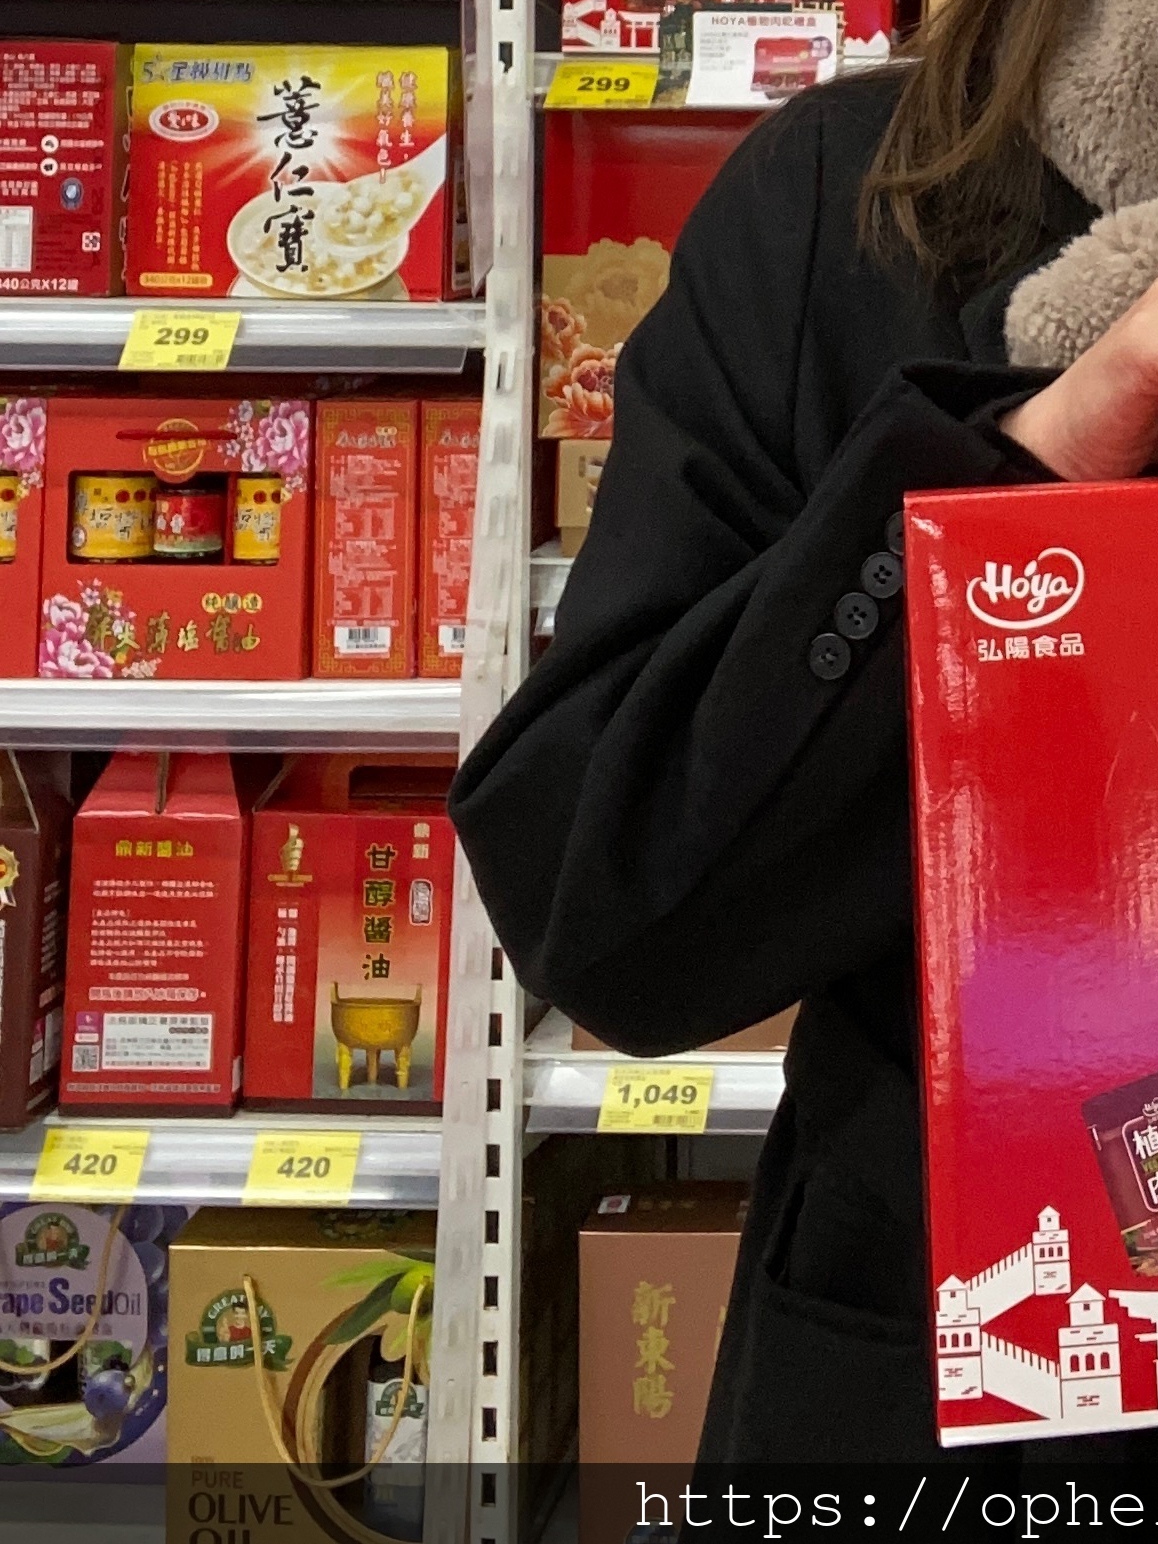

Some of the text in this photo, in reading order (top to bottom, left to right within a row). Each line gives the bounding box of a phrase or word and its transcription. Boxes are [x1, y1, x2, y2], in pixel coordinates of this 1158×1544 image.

[576, 76, 631, 92] 299
[257, 75, 321, 273] 薏仁寶
[153, 327, 210, 346] 299
[977, 632, 1085, 663] 弘陽食品
[362, 844, 397, 981] 甘醇醬油
[617, 1082, 698, 1109] 1,049
[62, 1153, 118, 1177] 420
[276, 1156, 331, 1180] 420
[114, 1290, 140, 1316] Oil
[631, 1280, 676, 1419] 新東陽
[191, 1470, 243, 1489] PURE
[188, 1492, 294, 1525] OLIVE
